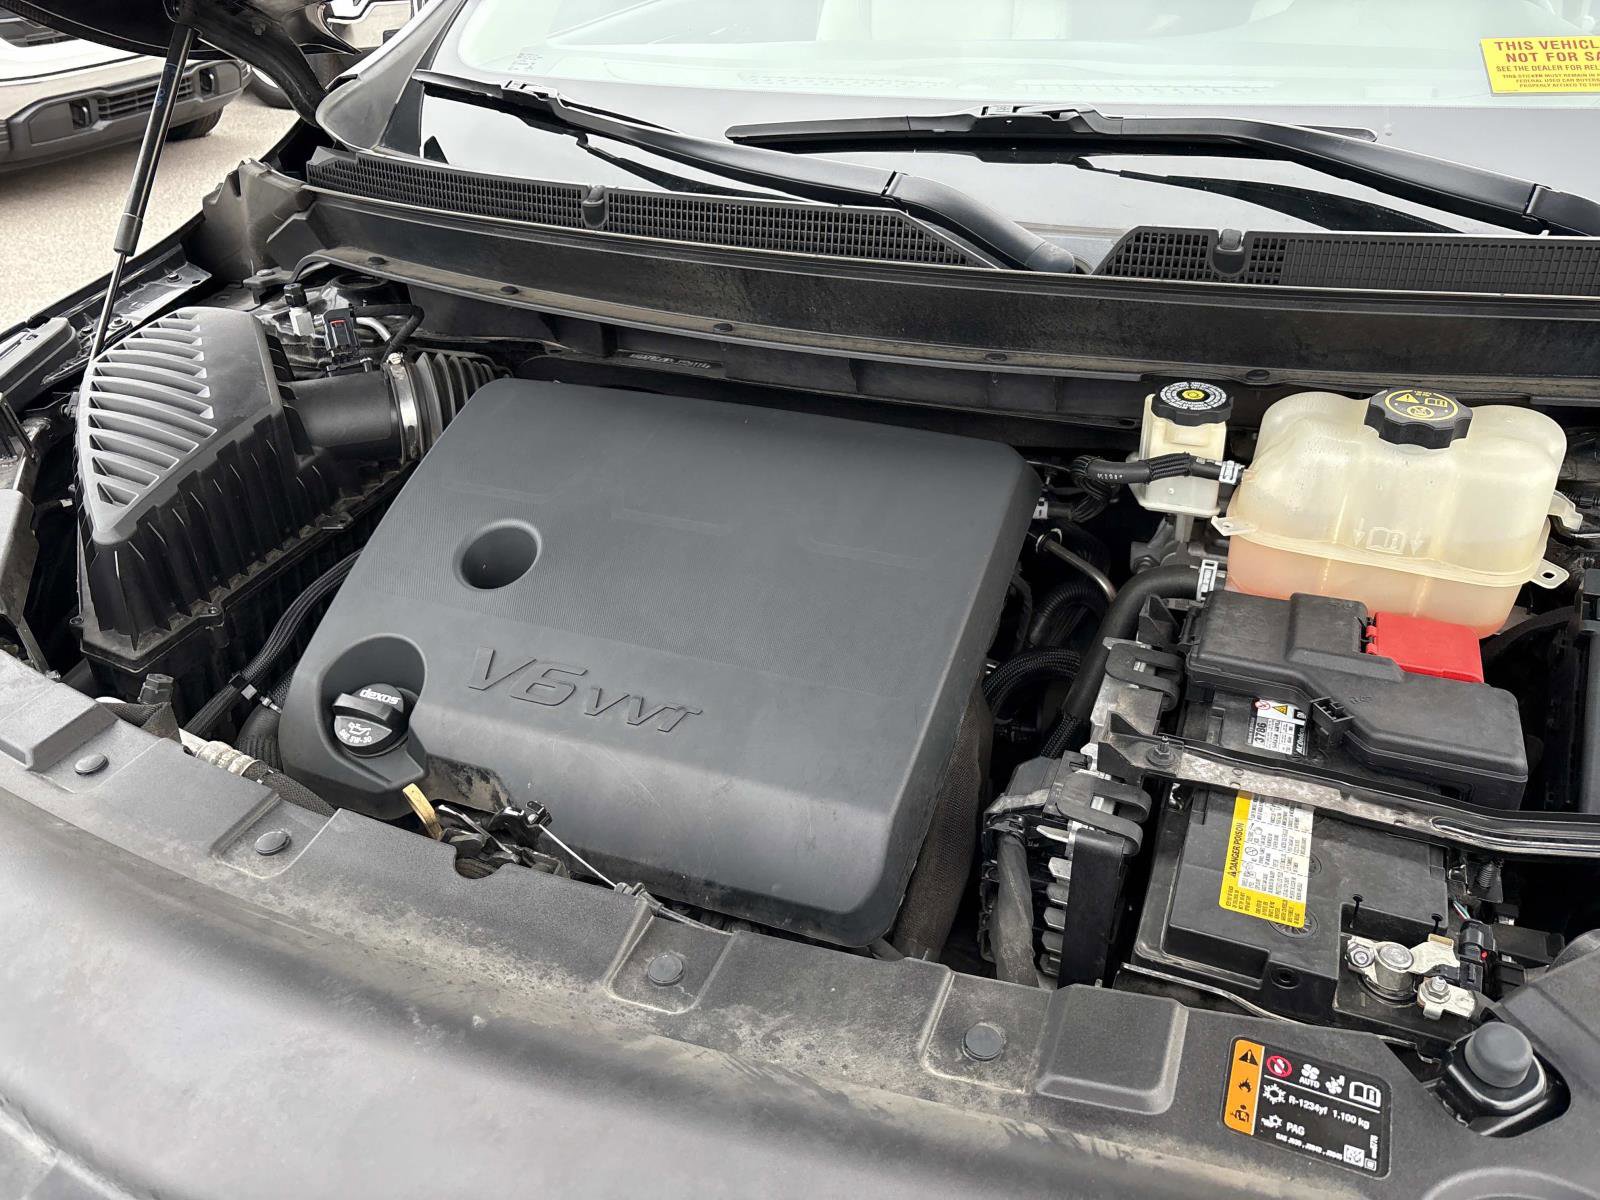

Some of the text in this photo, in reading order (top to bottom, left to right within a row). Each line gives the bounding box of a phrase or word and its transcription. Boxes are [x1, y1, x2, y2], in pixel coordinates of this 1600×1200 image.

[1494, 41, 1534, 51] THIS
[1505, 52, 1539, 63] NOT
[1545, 51, 1578, 62] FOR
[359, 688, 401, 705] dexos
[467, 646, 703, 733] V6 VVT
[1254, 722, 1267, 743] 3786
[1299, 1076, 1320, 1089] AUTO
[1288, 1095, 1370, 1130] R-1234yf 1.100 kg
[1286, 1122, 1305, 1136] PAG
